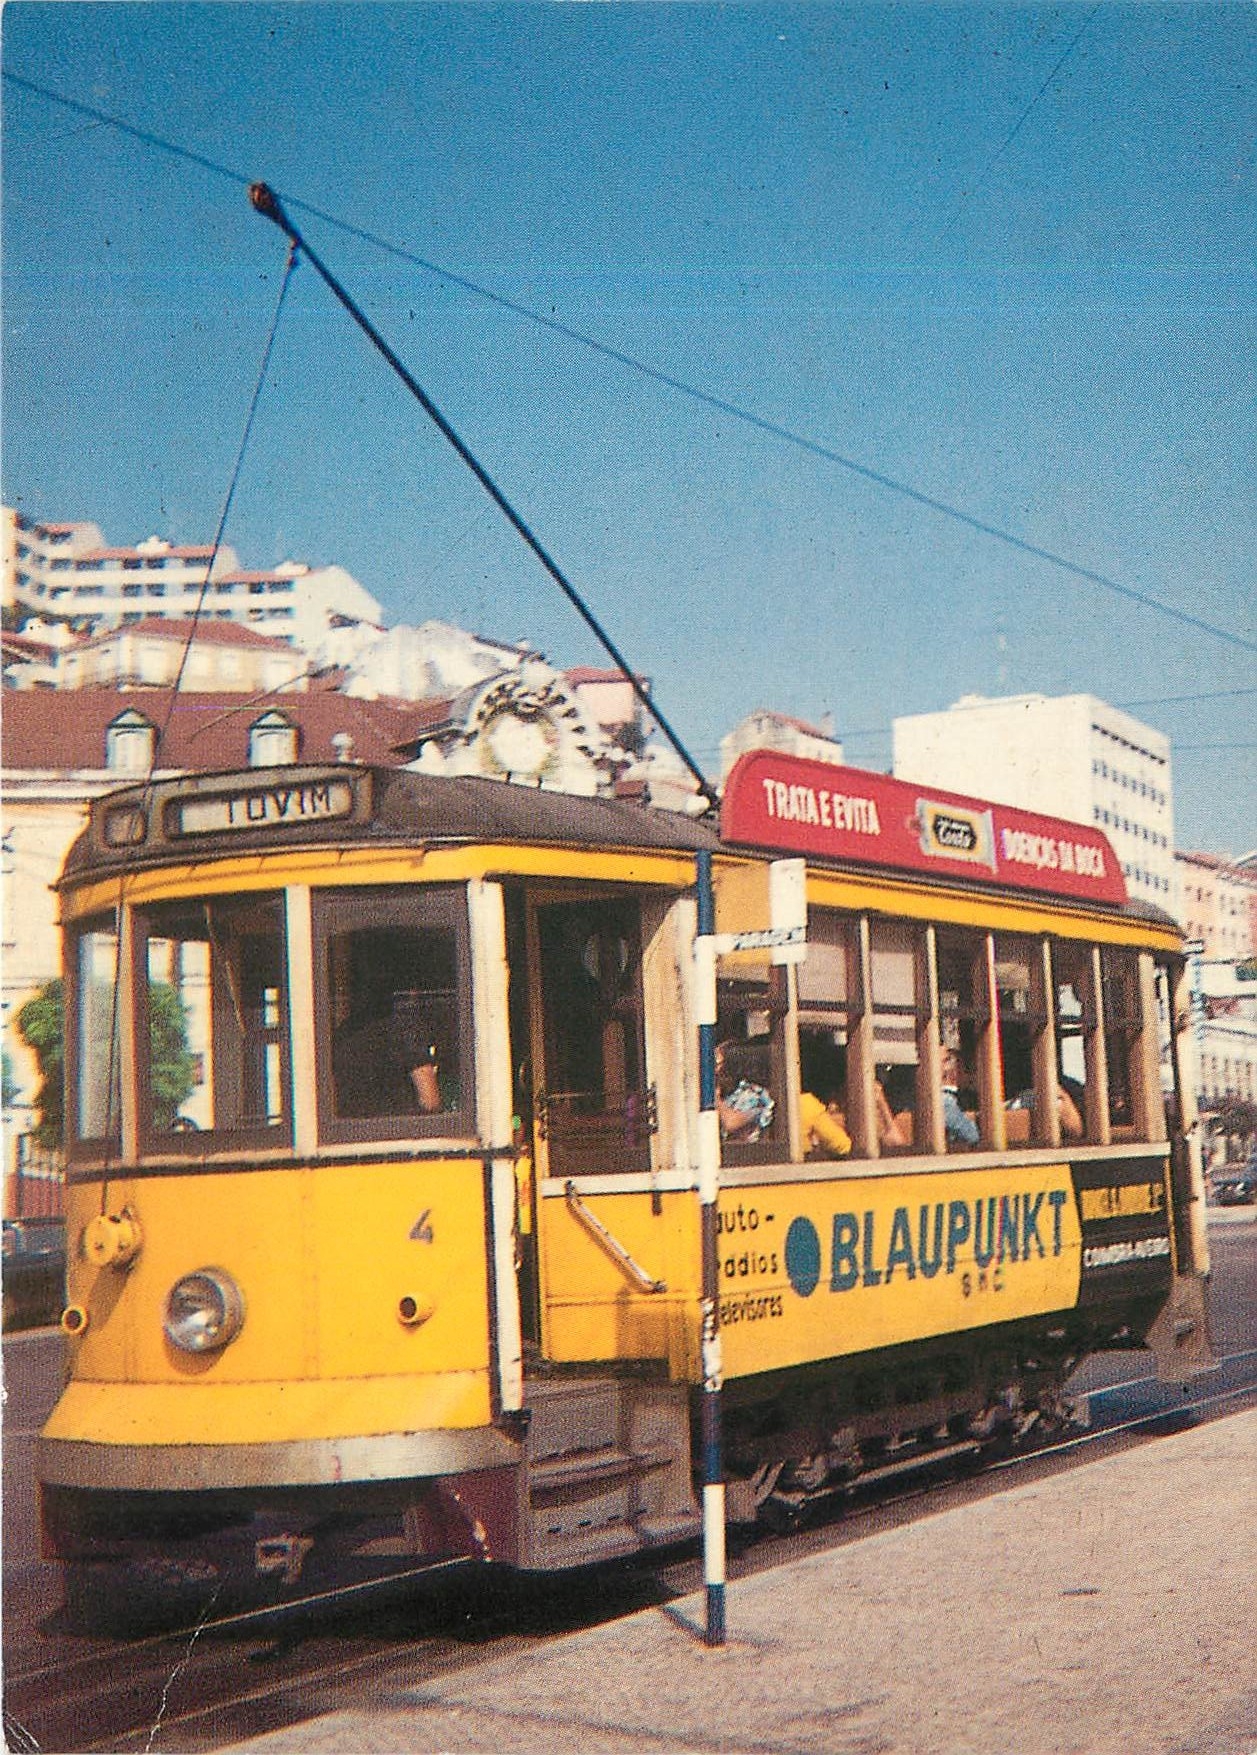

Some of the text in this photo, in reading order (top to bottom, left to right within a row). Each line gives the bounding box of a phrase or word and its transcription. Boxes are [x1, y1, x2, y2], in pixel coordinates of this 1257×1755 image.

[762, 778, 881, 835] TRATA E EVITA
[409, 1208, 433, 1244] 4
[829, 1190, 1067, 1293] BLAUPUNKT
[717, 1250, 778, 1278] adios
[719, 1292, 783, 1326] elevisores
